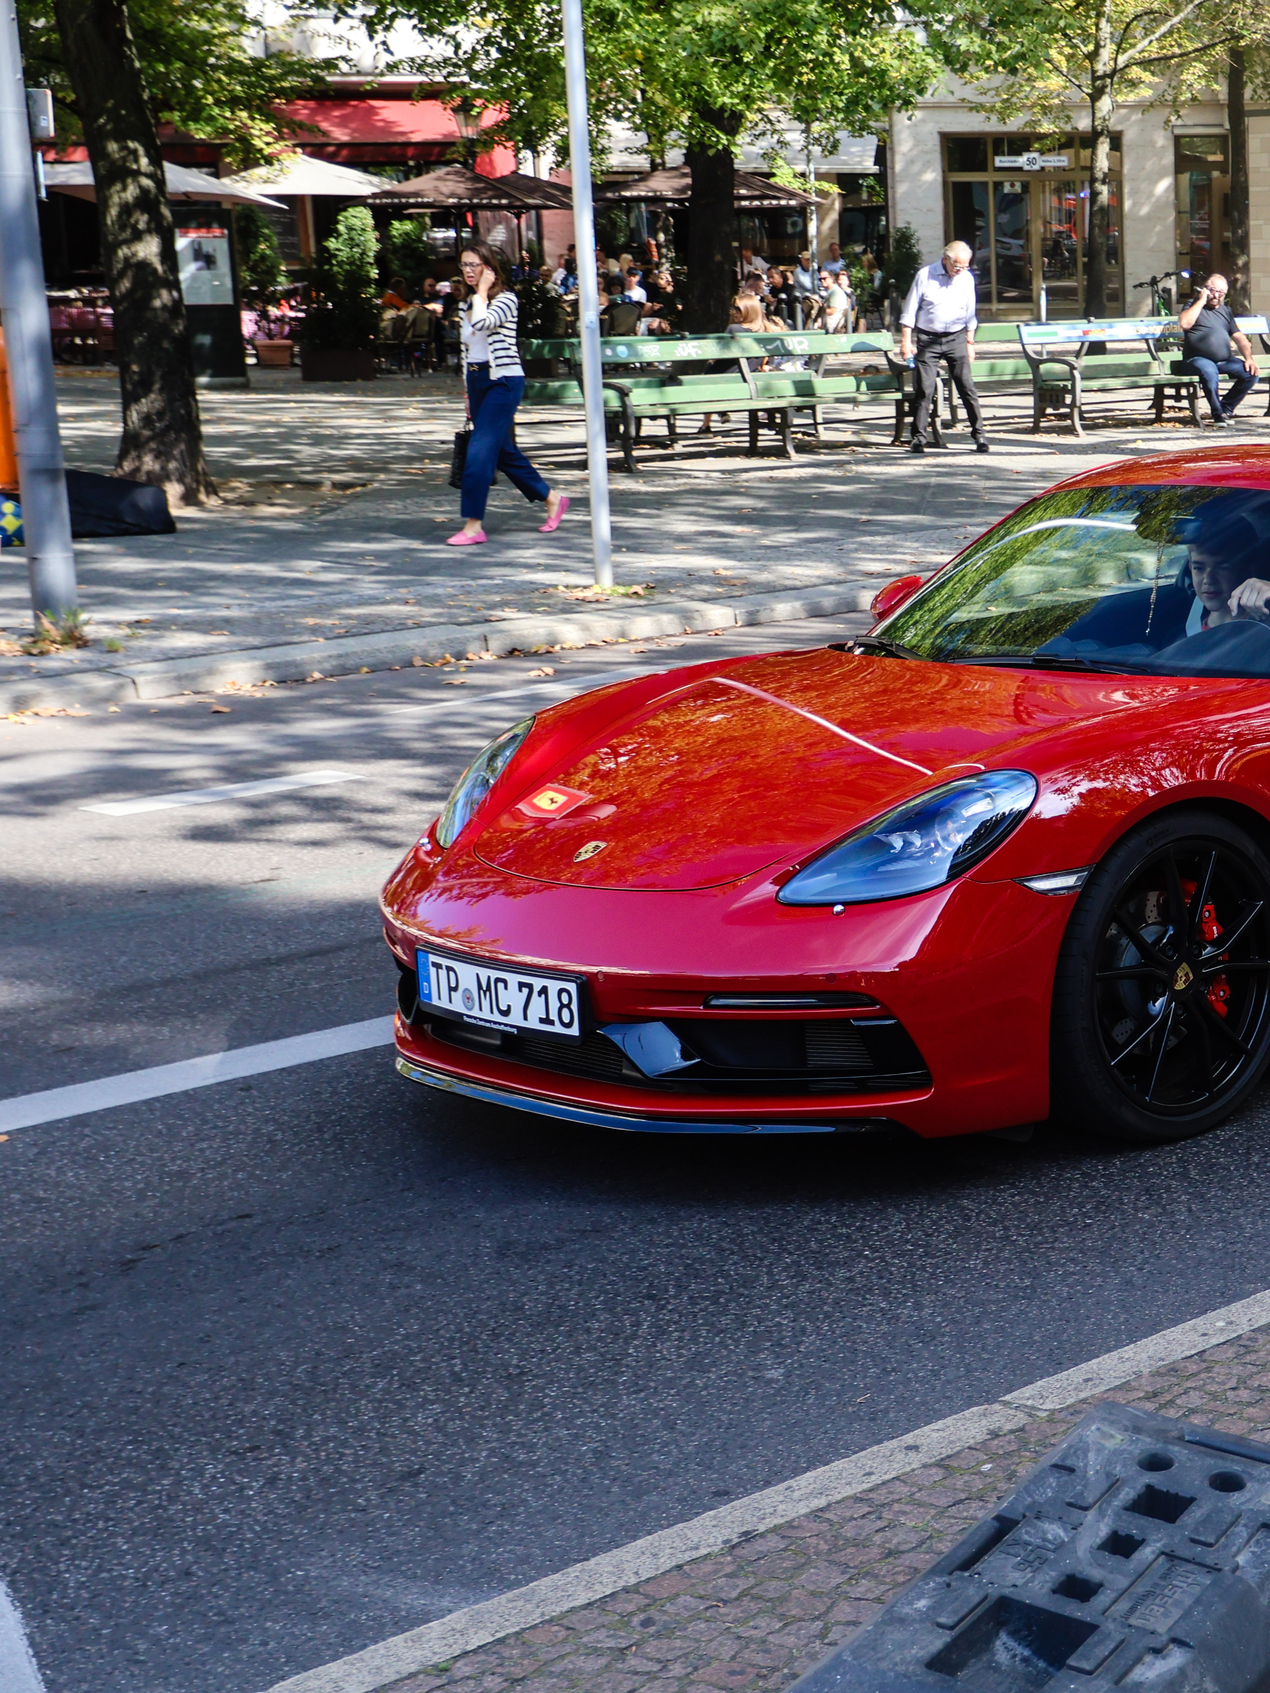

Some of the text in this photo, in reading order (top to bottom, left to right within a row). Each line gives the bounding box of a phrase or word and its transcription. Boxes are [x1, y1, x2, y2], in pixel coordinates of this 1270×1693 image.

[1026, 157, 1037, 166] 50
[431, 961, 575, 1029] TP MC 718
